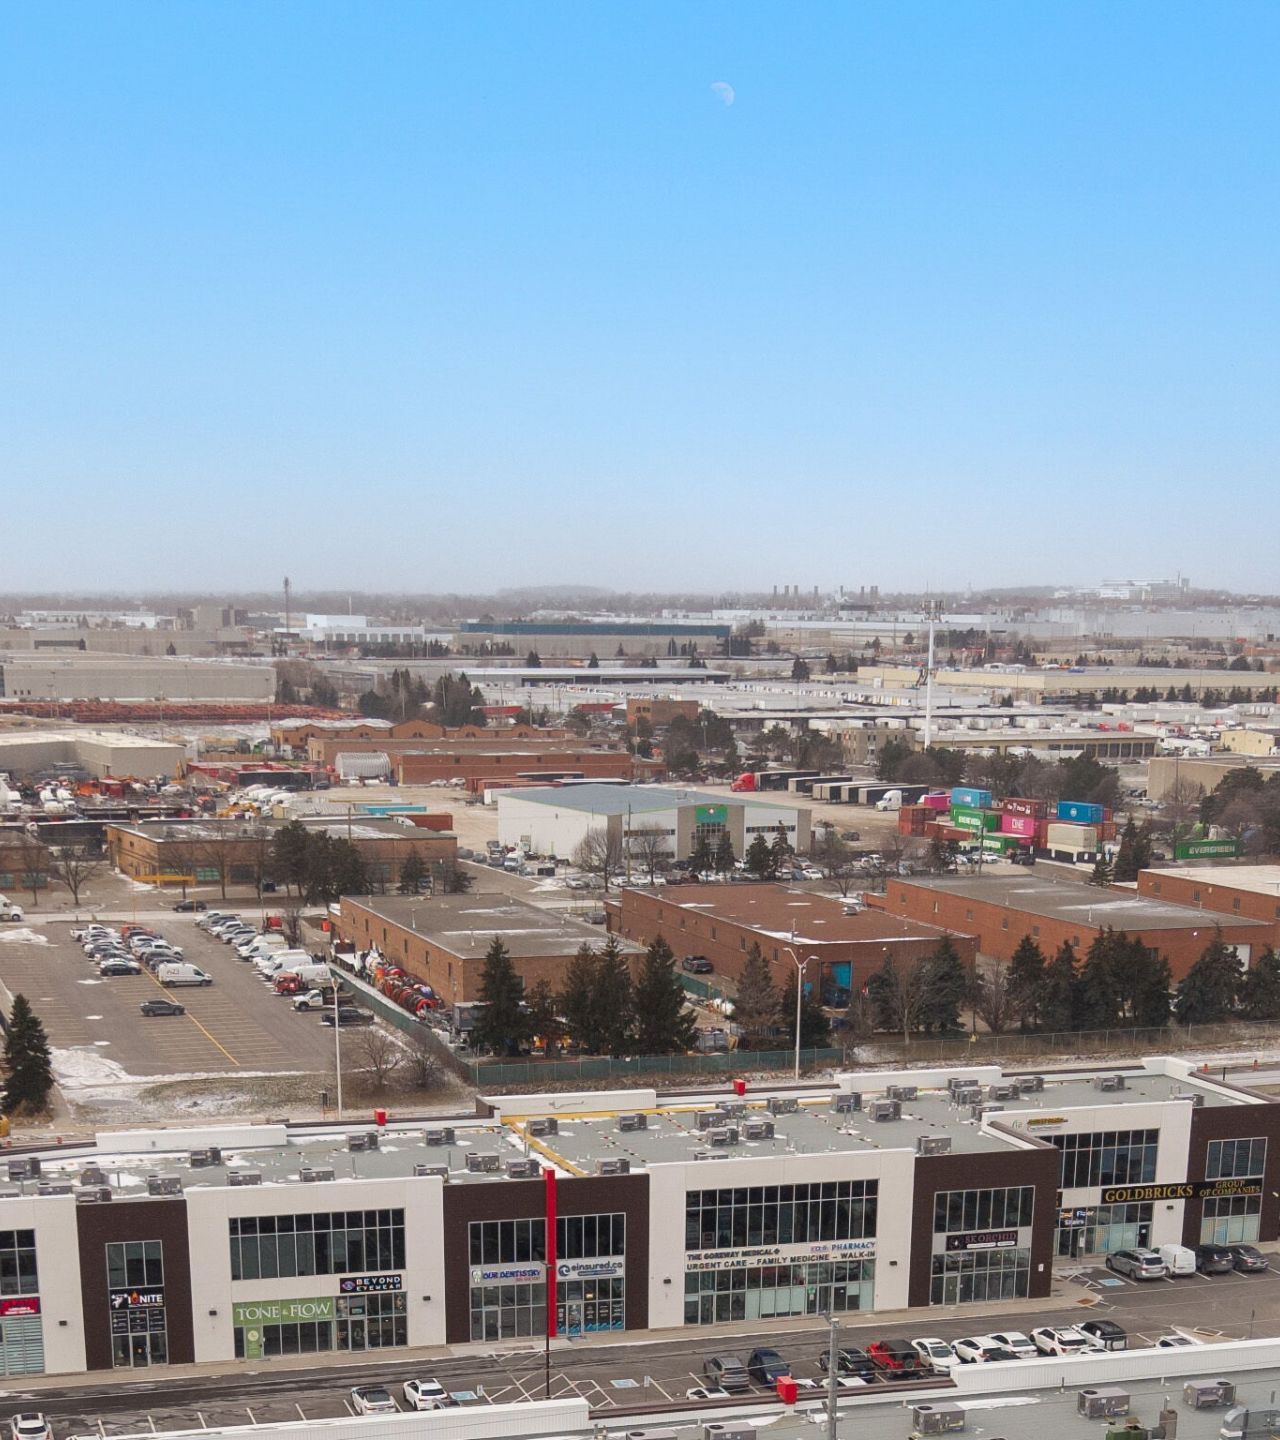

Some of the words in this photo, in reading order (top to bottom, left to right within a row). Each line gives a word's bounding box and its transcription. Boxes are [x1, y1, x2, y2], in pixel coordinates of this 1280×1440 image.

[1211, 1184, 1261, 1196] COMPANIES
[1215, 1179, 1246, 1189] GROUP
[1105, 1185, 1194, 1202] GOLDBRICKS
[977, 1232, 1017, 1243] ORCHID
[831, 1241, 876, 1251] PHARMACY
[686, 1252, 702, 1261] THE
[741, 1248, 774, 1257] MEDICAL
[686, 1261, 722, 1271] URGENT
[724, 1259, 747, 1268] CARE
[756, 1255, 788, 1266] FAMILY
[789, 1253, 830, 1263] MEDICINE
[840, 1250, 876, 1260] WALK-IN
[571, 1260, 623, 1272] einsured.ca
[499, 1268, 541, 1279] DENTISTRY
[356, 1276, 401, 1286] BEYOND
[236, 1305, 281, 1321] TONE
[290, 1302, 332, 1319] FLOW
